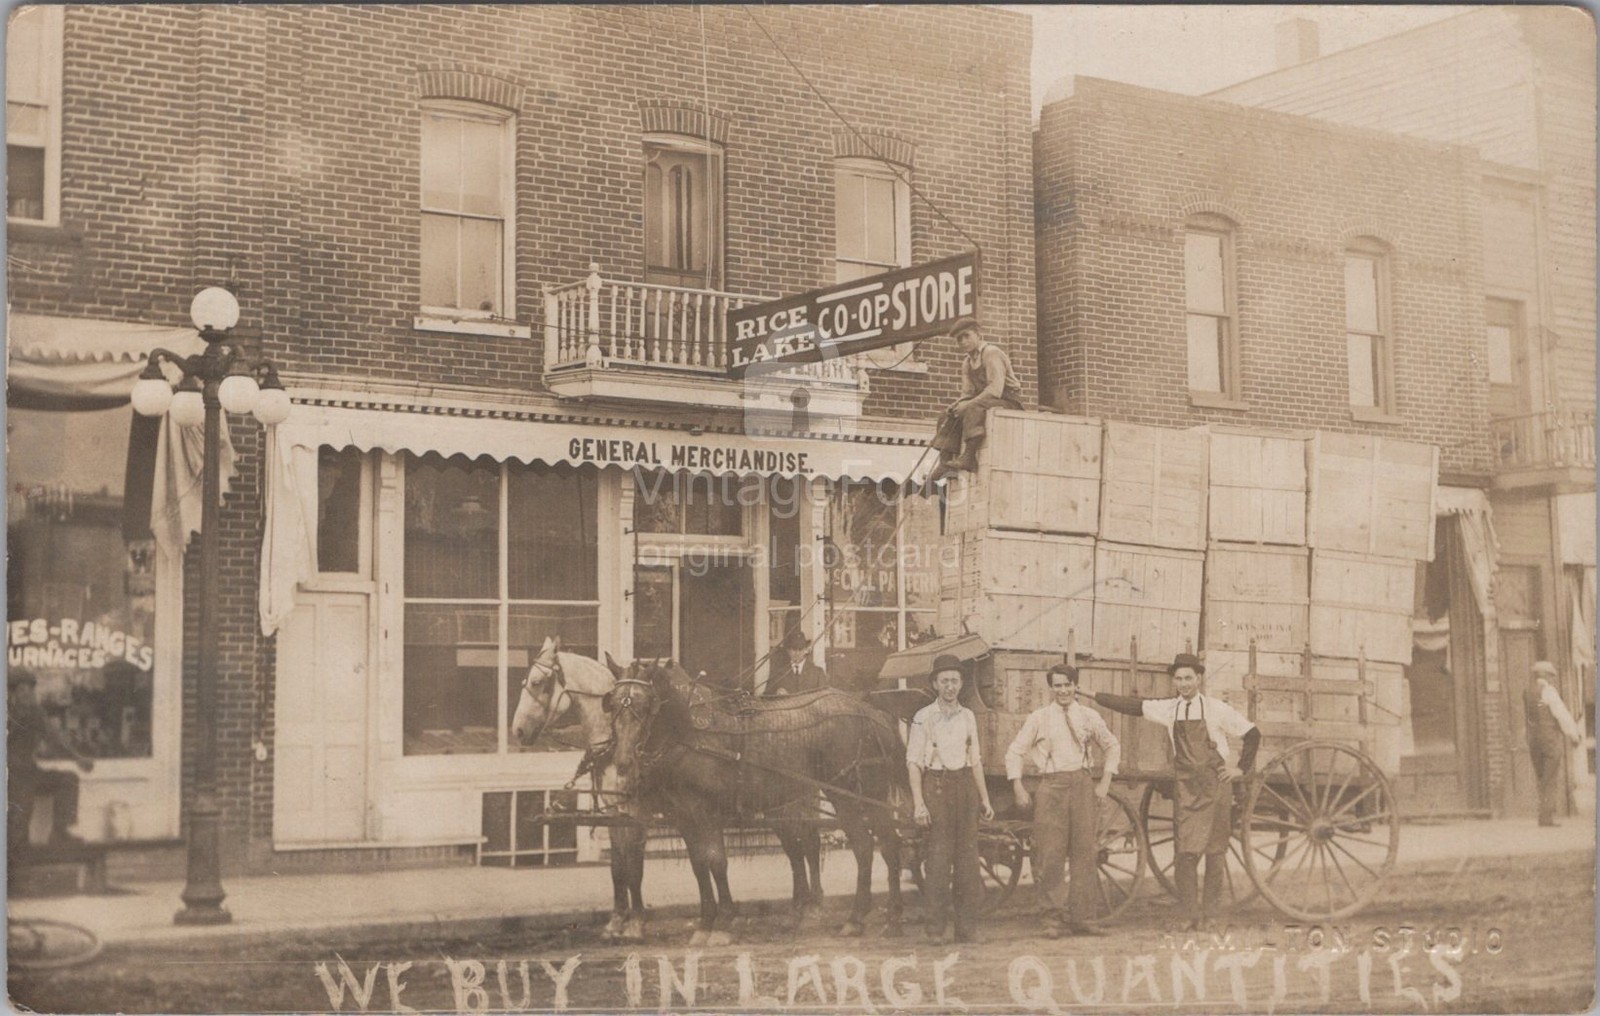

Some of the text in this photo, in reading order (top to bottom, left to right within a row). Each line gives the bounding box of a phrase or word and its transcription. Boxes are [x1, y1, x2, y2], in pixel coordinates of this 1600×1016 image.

[891, 265, 973, 331] STORE
[735, 305, 808, 341] RICE
[731, 330, 815, 368] LAKE
[568, 437, 814, 473] GENERAL MERCHANDISE.
[7, 617, 153, 672] ES-RANGES
